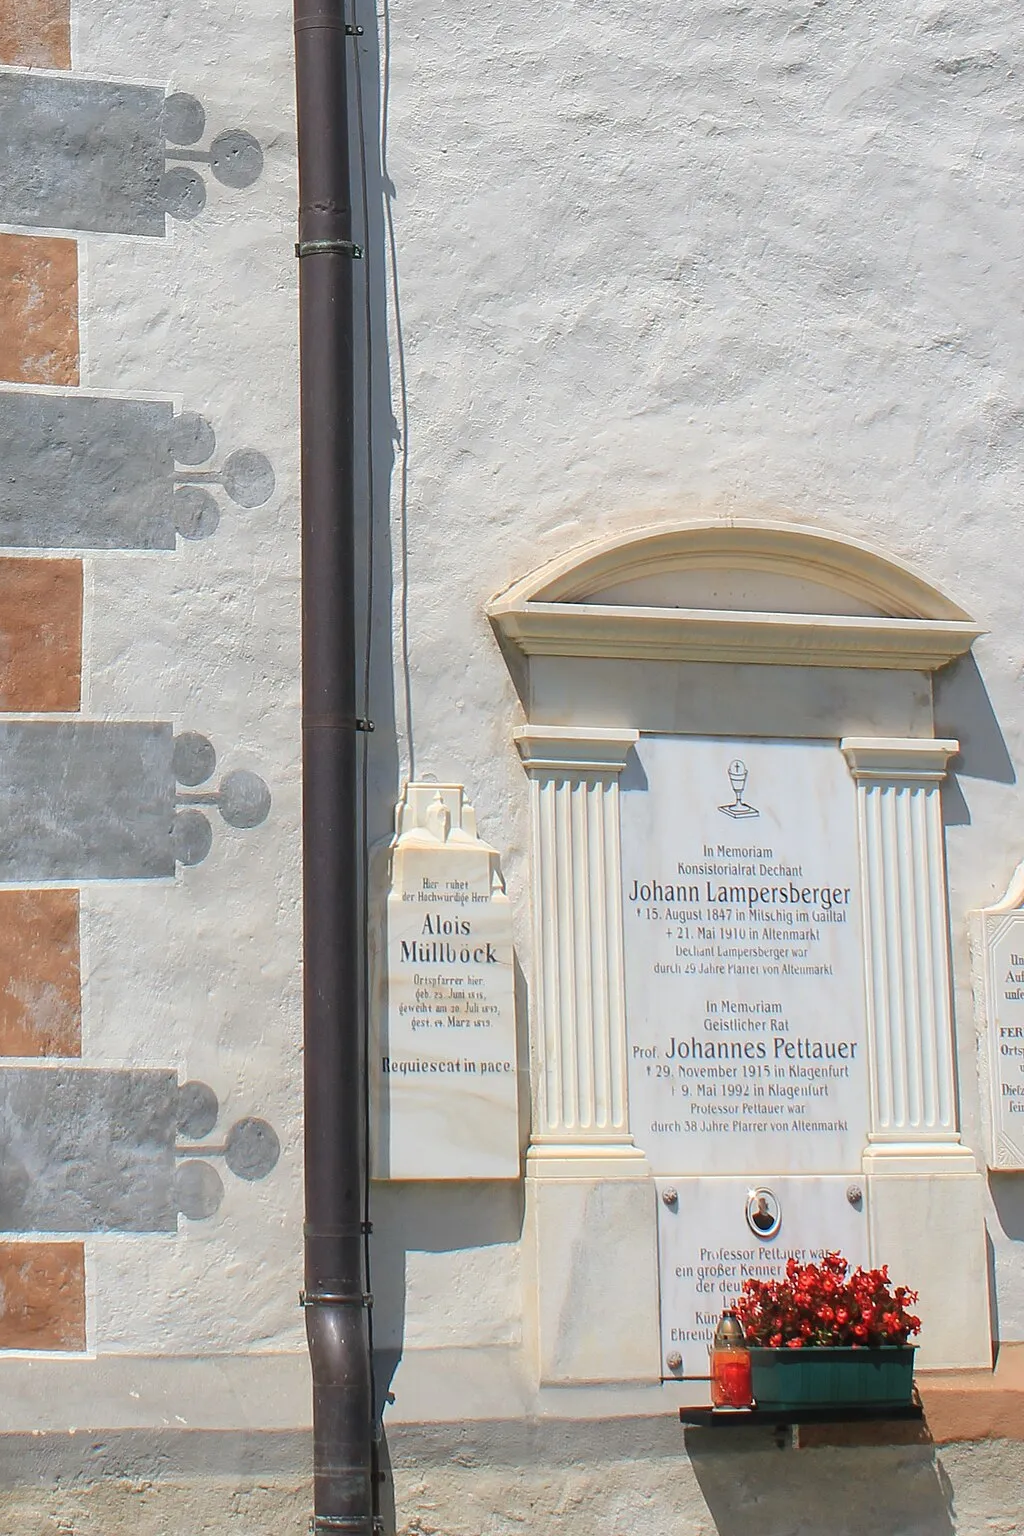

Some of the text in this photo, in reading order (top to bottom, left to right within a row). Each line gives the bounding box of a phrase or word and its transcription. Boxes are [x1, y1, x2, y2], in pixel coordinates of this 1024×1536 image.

[703, 845, 773, 858] In Memoriam
[678, 863, 803, 876] Konsistorialrat Dechant
[423, 878, 468, 889] Hier ruhet
[402, 892, 414, 901] der
[472, 893, 489, 902] Herr
[629, 880, 850, 909] Johann Lampersberger
[646, 908, 662, 920] 15.
[665, 909, 702, 923] August
[707, 909, 732, 920] 1847
[736, 910, 745, 921] in
[796, 911, 809, 921] im
[812, 910, 846, 922] Gailtal
[422, 913, 470, 935] Alois
[677, 928, 820, 940] 21. Mai 1910 in Altenmarkt
[400, 941, 497, 963] Müllböck
[676, 946, 807, 959] Dechant Lampersberger war
[654, 963, 680, 973] durch
[699, 964, 724, 974] Jahre
[762, 966, 778, 974] von
[782, 964, 832, 975] Altenmarkt
[414, 974, 463, 986] Ortspfarrer
[415, 989, 431, 1002] geb.
[448, 988, 465, 999] Juni
[399, 1003, 431, 1016] geweiht
[465, 1002, 478, 1013] Juli
[706, 1001, 782, 1013] In Memoriam
[411, 1017, 432, 1031] gest.
[704, 1019, 789, 1031] Geistlicher Rat
[633, 1037, 857, 1058] Prof. Johannes Pettauer
[382, 1057, 514, 1077] Requiescat in pace.
[656, 1065, 849, 1080] 29. November 1915 in Klagenfurt
[681, 1084, 828, 1099] 9. Mai 1992 in Klagenfurt
[691, 1103, 805, 1114] Professor Pettauer war
[651, 1121, 848, 1132] durch 38 Jahre Pfarrer von Altenmarkt
[700, 1248, 829, 1260] Professor Pettauer war
[676, 1265, 781, 1280] ein großer Kenner
[696, 1281, 714, 1292] der
[723, 1296, 739, 1308] La
[671, 1329, 715, 1341] Ehrenb
